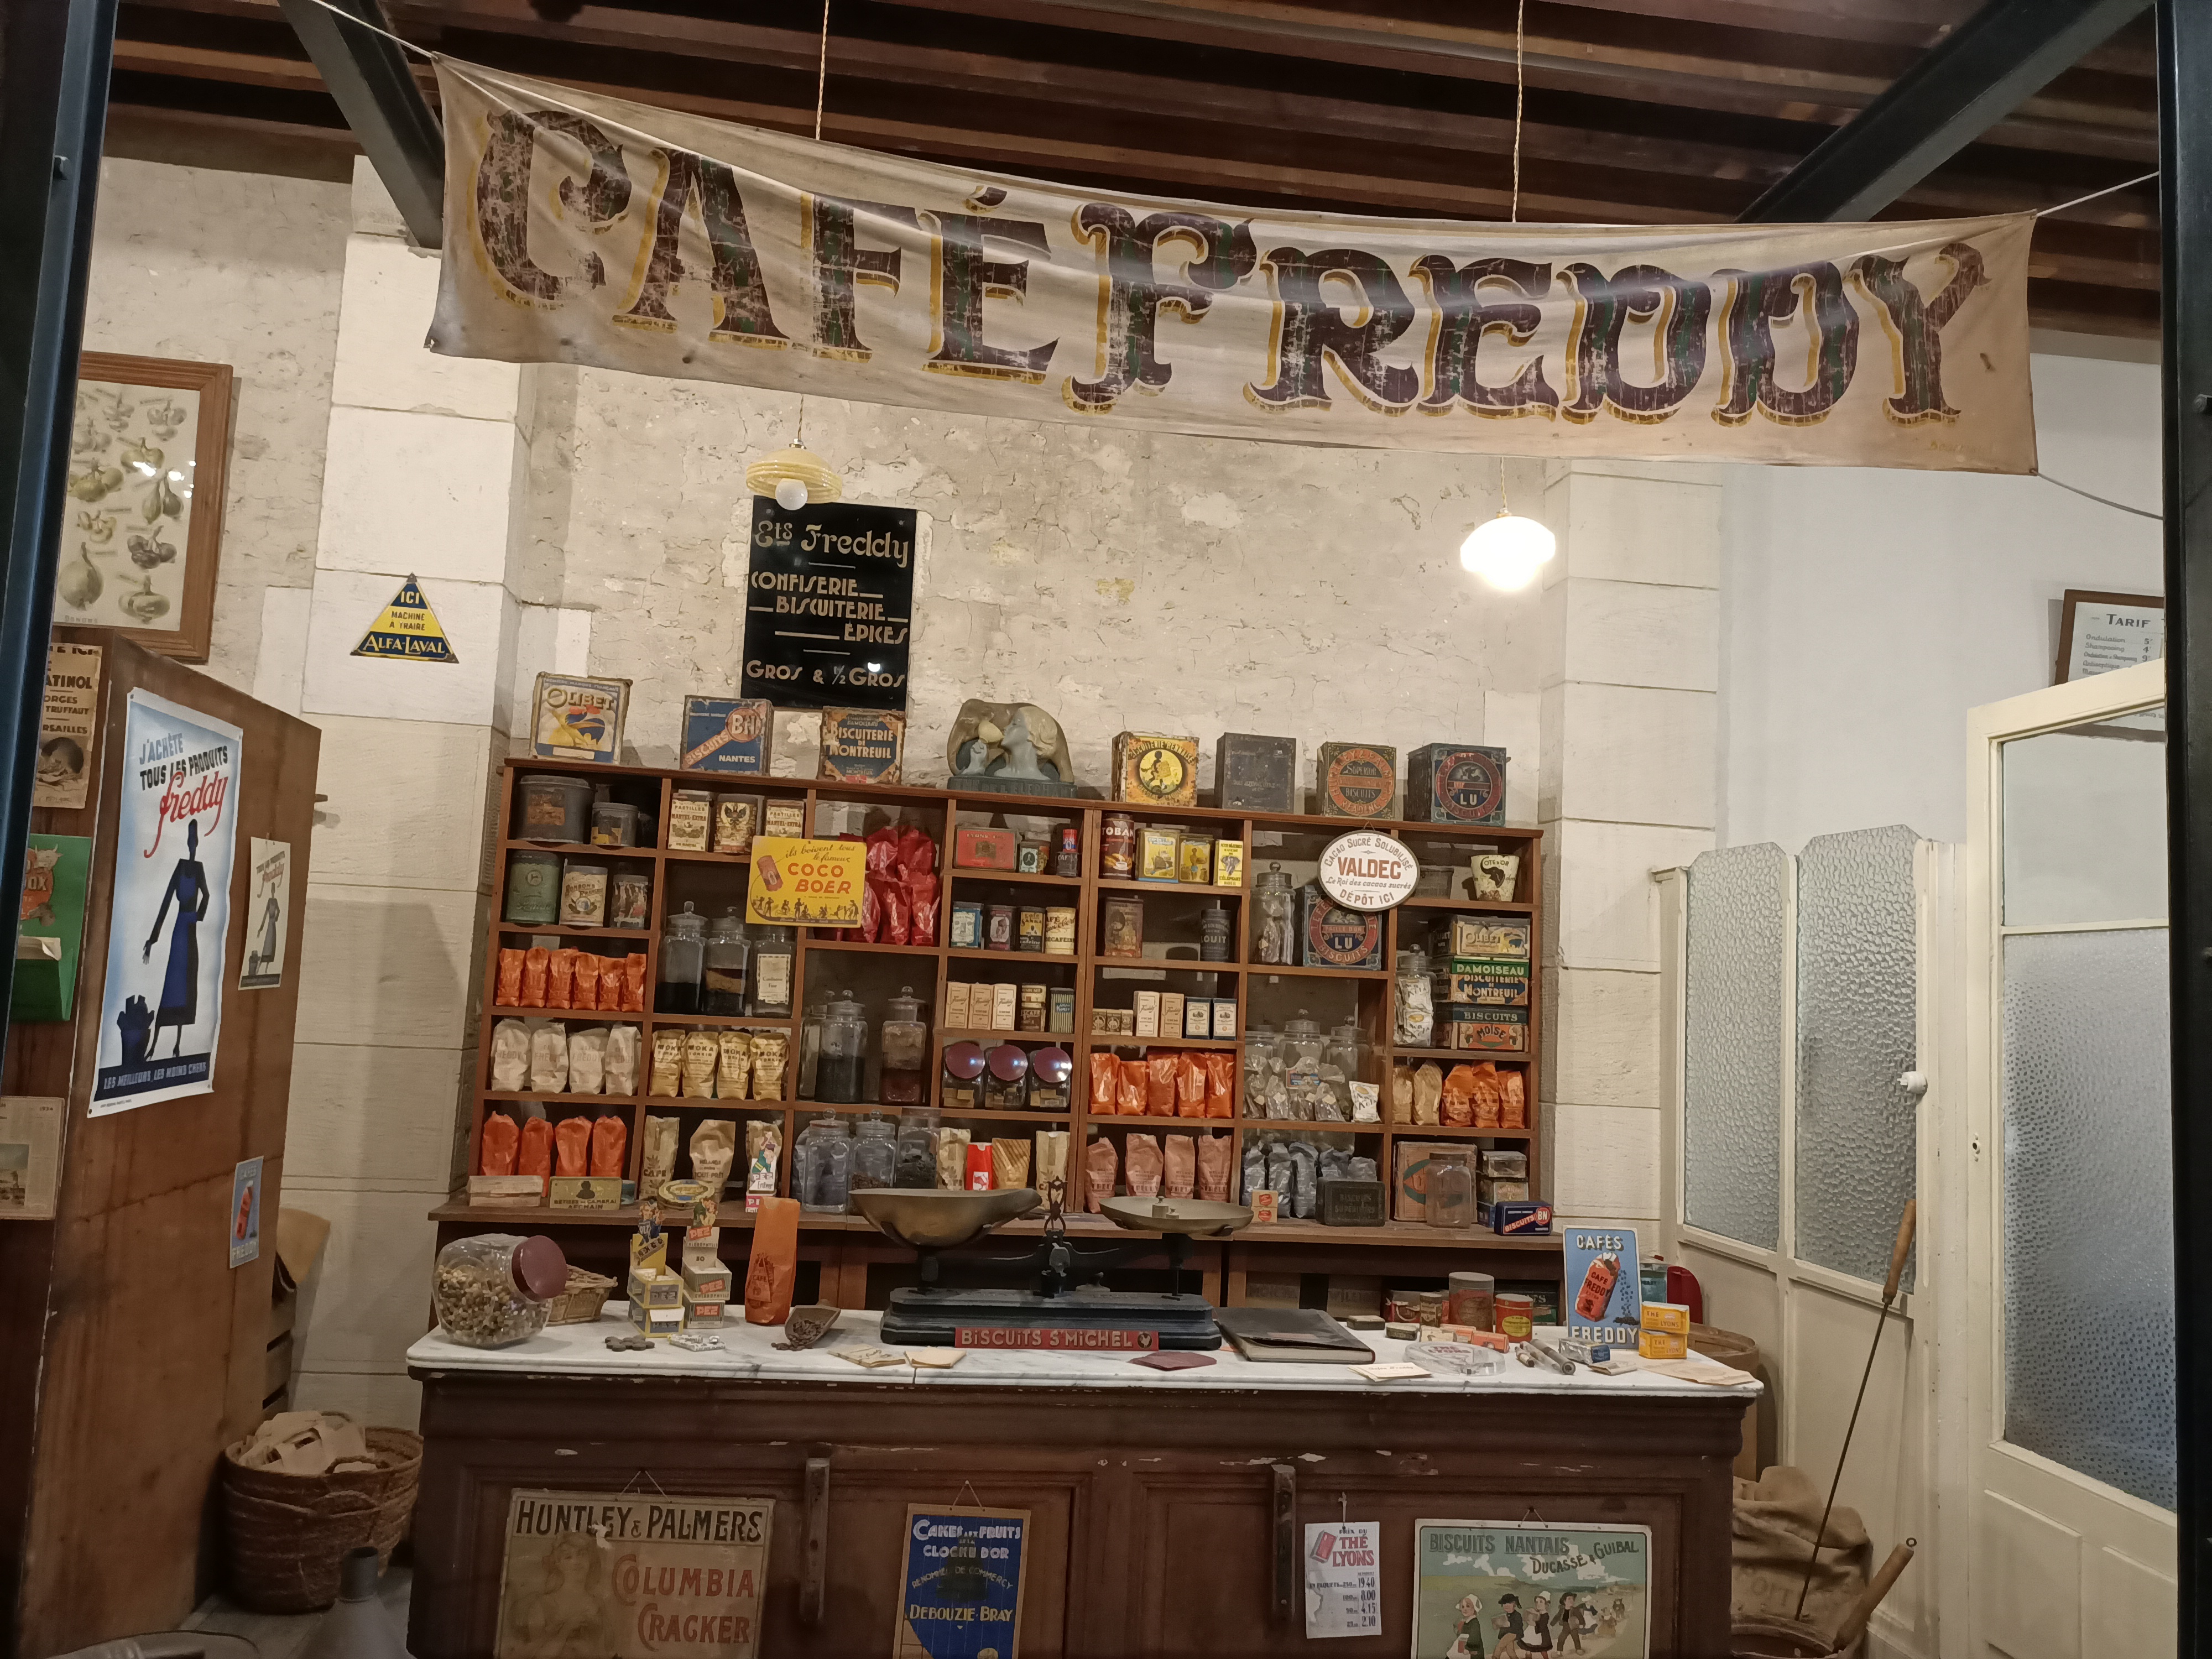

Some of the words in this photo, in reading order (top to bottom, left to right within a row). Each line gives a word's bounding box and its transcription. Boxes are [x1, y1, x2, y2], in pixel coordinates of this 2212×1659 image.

[466, 109, 1060, 384] CAFÉ
[1063, 202, 1993, 427] FREDDY
[801, 524, 909, 568] Freddy
[751, 571, 858, 596] CONFISERIE
[401, 591, 419, 604] ICI
[392, 611, 425, 620] MACHINE
[776, 597, 885, 621] BISCUITERIE
[399, 622, 425, 630] TRAIRE
[813, 669, 824, 684] &
[46, 706, 89, 714] TRUFFAUT
[831, 721, 893, 741] BISCUITERIE
[139, 733, 184, 765] J'ACHÈTE
[685, 731, 729, 765] BISCUITS
[830, 745, 891, 759] MONTREUIL
[1359, 750, 1364, 758] &
[719, 755, 755, 763] NANTES
[140, 765, 166, 791] TOUS
[170, 759, 187, 781] LES
[189, 745, 228, 777] PRODUITS
[1345, 787, 1375, 798] BISCUITS
[1460, 793, 1477, 805] LU
[786, 846, 797, 858] ils
[801, 844, 833, 854] boivent
[820, 854, 851, 863] fameux
[1324, 844, 1345, 867] CACAO
[787, 863, 844, 878] COCO
[1338, 857, 1401, 879] VALDEC
[795, 879, 851, 894] BOER
[1337, 877, 1348, 886] Roi
[1339, 889, 1374, 905] DÉPÔT
[1379, 892, 1395, 904] ICI
[1335, 937, 1352, 949] LU
[1318, 945, 1368, 962] BISCUITS
[1457, 963, 1524, 975] DAMOISEAU
[1464, 975, 1519, 984] BISCUITERIE
[1464, 984, 1518, 998] MONTREUIL
[1464, 1011, 1518, 1021] BISCUITS
[1537, 1211, 1548, 1220] BN
[1505, 1215, 1535, 1232] BISCUITS
[690, 1227, 711, 1239] PEZ
[701, 1280, 723, 1293] PEZ
[1584, 1279, 1611, 1297] FREDDY
[650, 1291, 677, 1300] PEZ
[696, 1306, 719, 1315] PEZ
[1572, 1326, 1638, 1344] FREDDY
[515, 1499, 633, 1538] HUNTLEY
[646, 1505, 764, 1543] PALMERS
[913, 1519, 963, 1540] CAKES
[979, 1526, 1021, 1539] FRUITS
[1428, 1533, 1495, 1554] BISCUITS
[1504, 1535, 1571, 1556] NANTAIS
[1332, 1550, 1375, 1567] LYONS
[1529, 1554, 1588, 1574] DUCASSE
[1593, 1541, 1639, 1560] GUIBAL
[612, 1553, 754, 1606] COLUMBIA
[955, 1566, 966, 1574] DE
[968, 1566, 1013, 1589] COMMERCY
[980, 1606, 1013, 1621] BRAY
[638, 1603, 750, 1652] CRACKER
